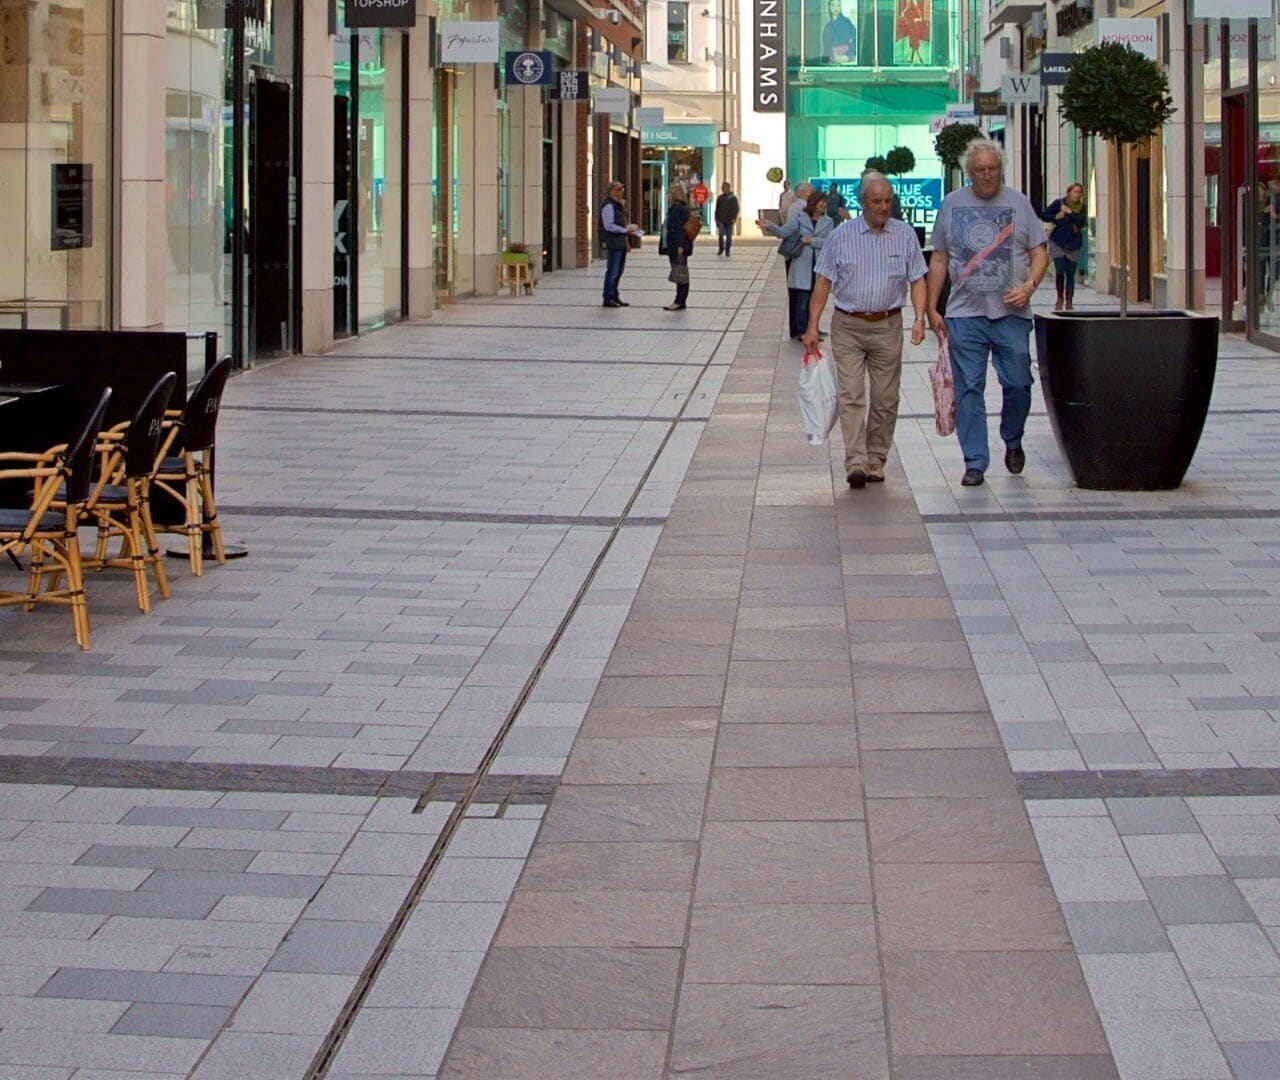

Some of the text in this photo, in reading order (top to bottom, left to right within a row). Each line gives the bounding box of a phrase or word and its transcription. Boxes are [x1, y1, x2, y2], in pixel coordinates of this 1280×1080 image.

[1103, 34, 1153, 44] MONSOON
[1010, 78, 1031, 93] W
[900, 195, 933, 207] ROSS
